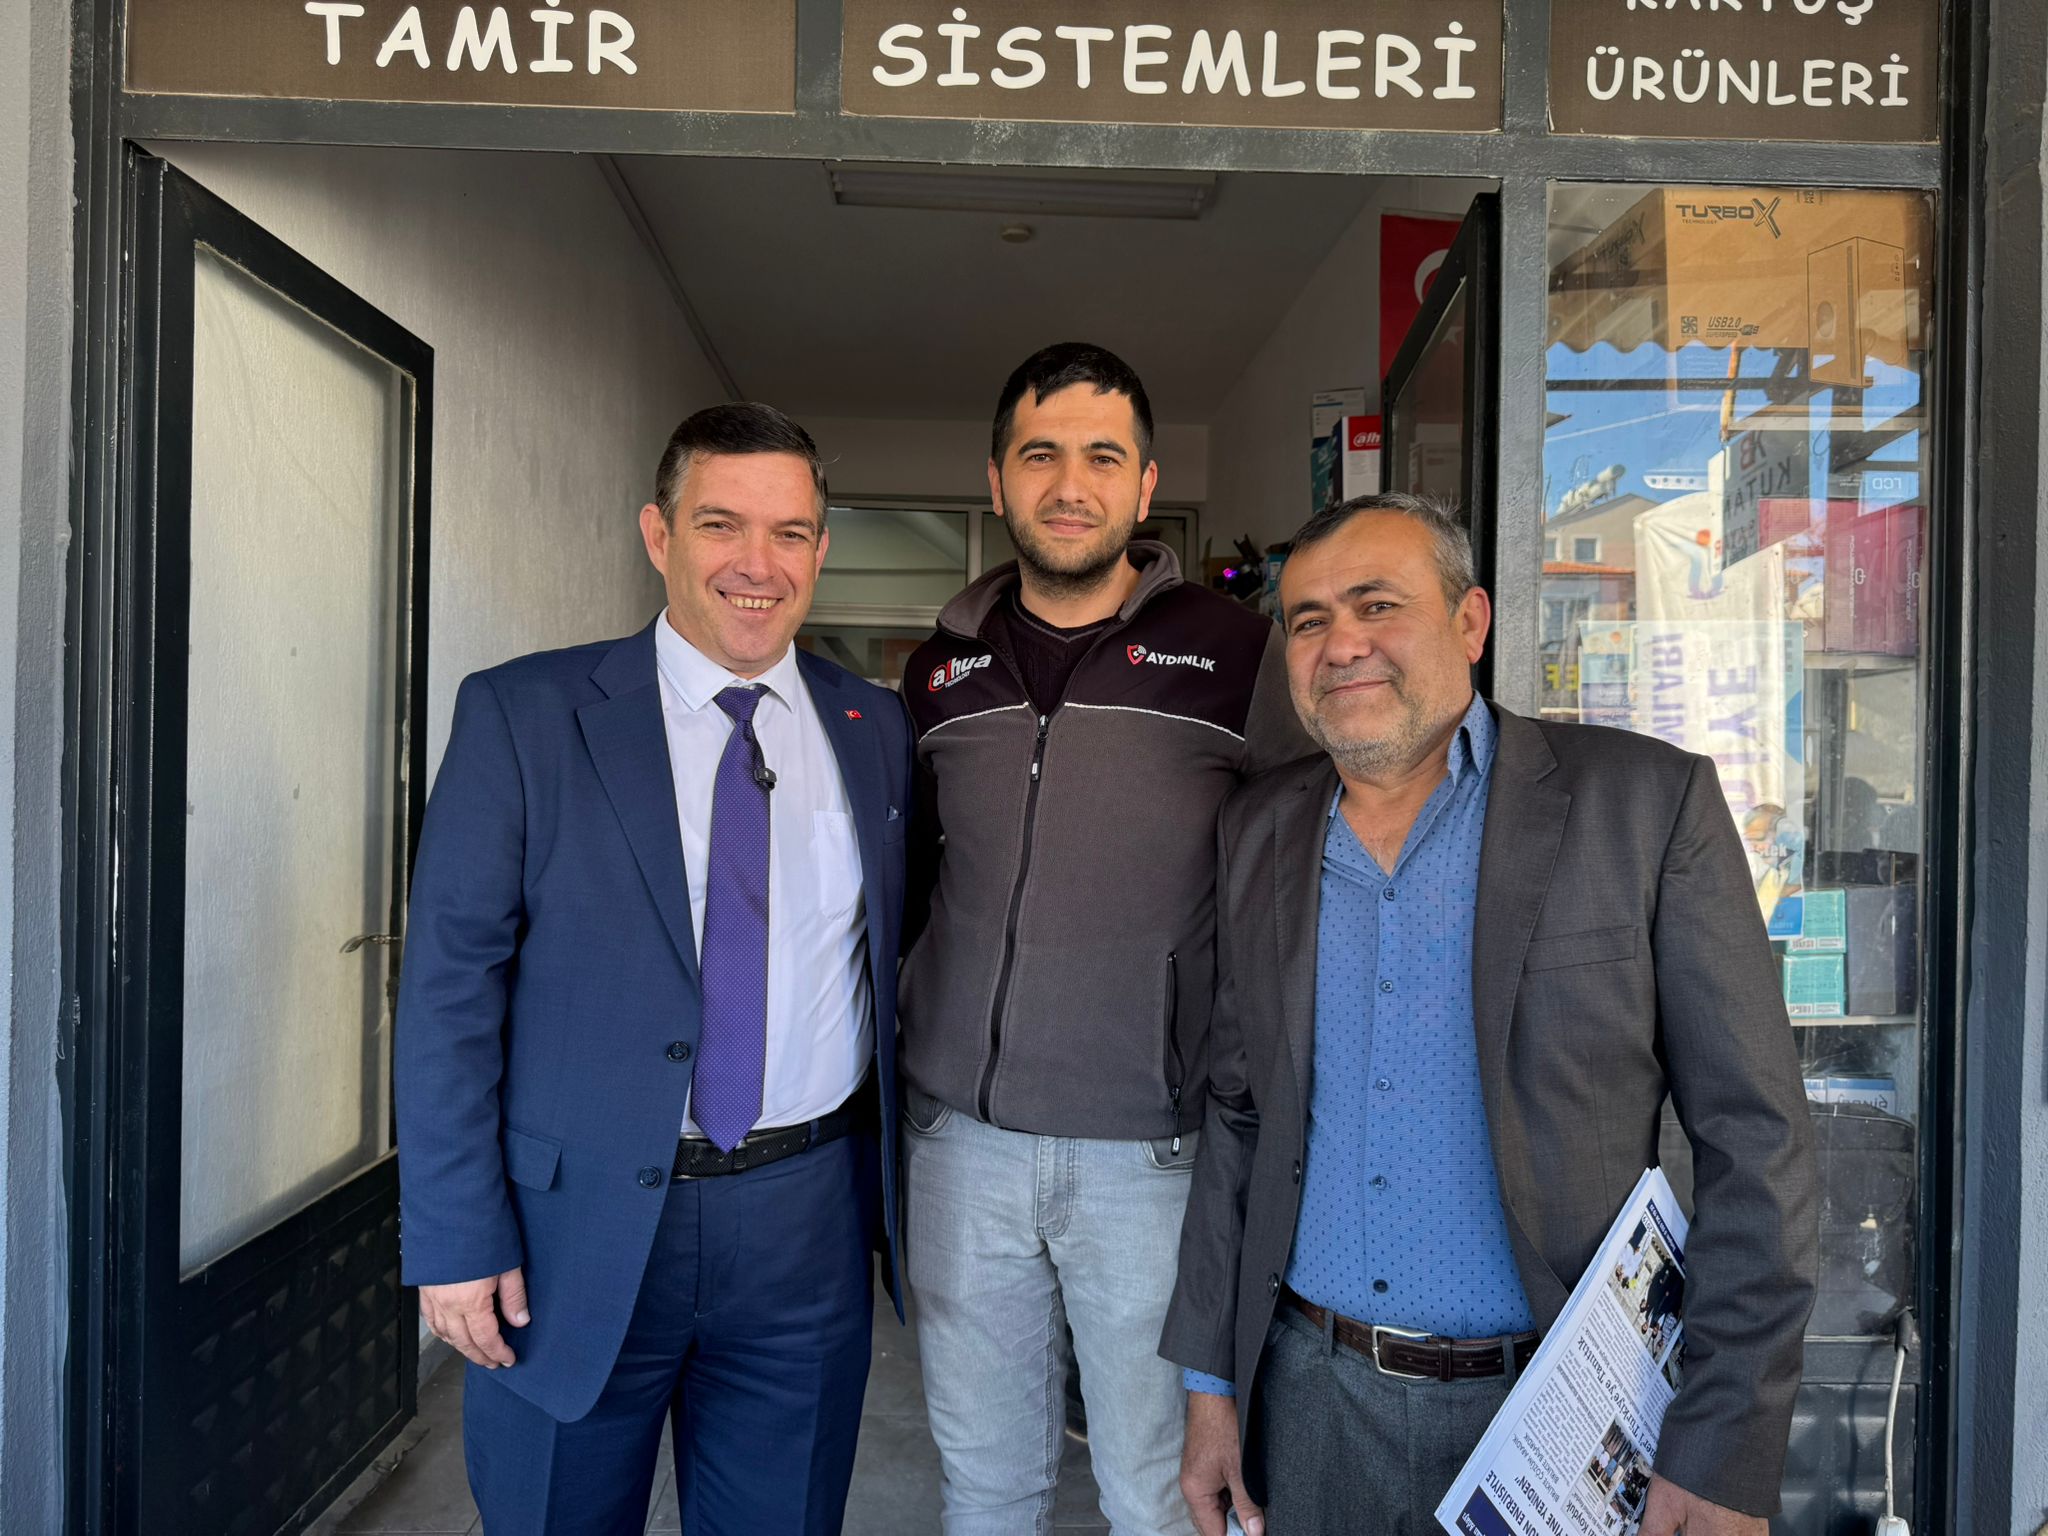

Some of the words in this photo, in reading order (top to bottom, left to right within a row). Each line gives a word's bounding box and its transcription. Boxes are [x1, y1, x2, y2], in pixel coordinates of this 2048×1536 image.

[305, 0, 637, 75] TAMİR
[872, 7, 1477, 100] SİSTEMLERİ
[1587, 46, 1909, 106] ÜRÜNLERİ
[1872, 477, 1902, 490] LCD
[944, 671, 970, 688] TECHNOLOGY
[1146, 651, 1216, 672] AYDINLIK
[1577, 1336, 1606, 1384] Tanıttık
[1604, 1379, 1640, 1437] Türkiye'ye
[1461, 1512, 1475, 1531] Adayı
[1485, 1470, 1526, 1525] ENERJİSİYLE
[1563, 1499, 1589, 1533] Koyduk
